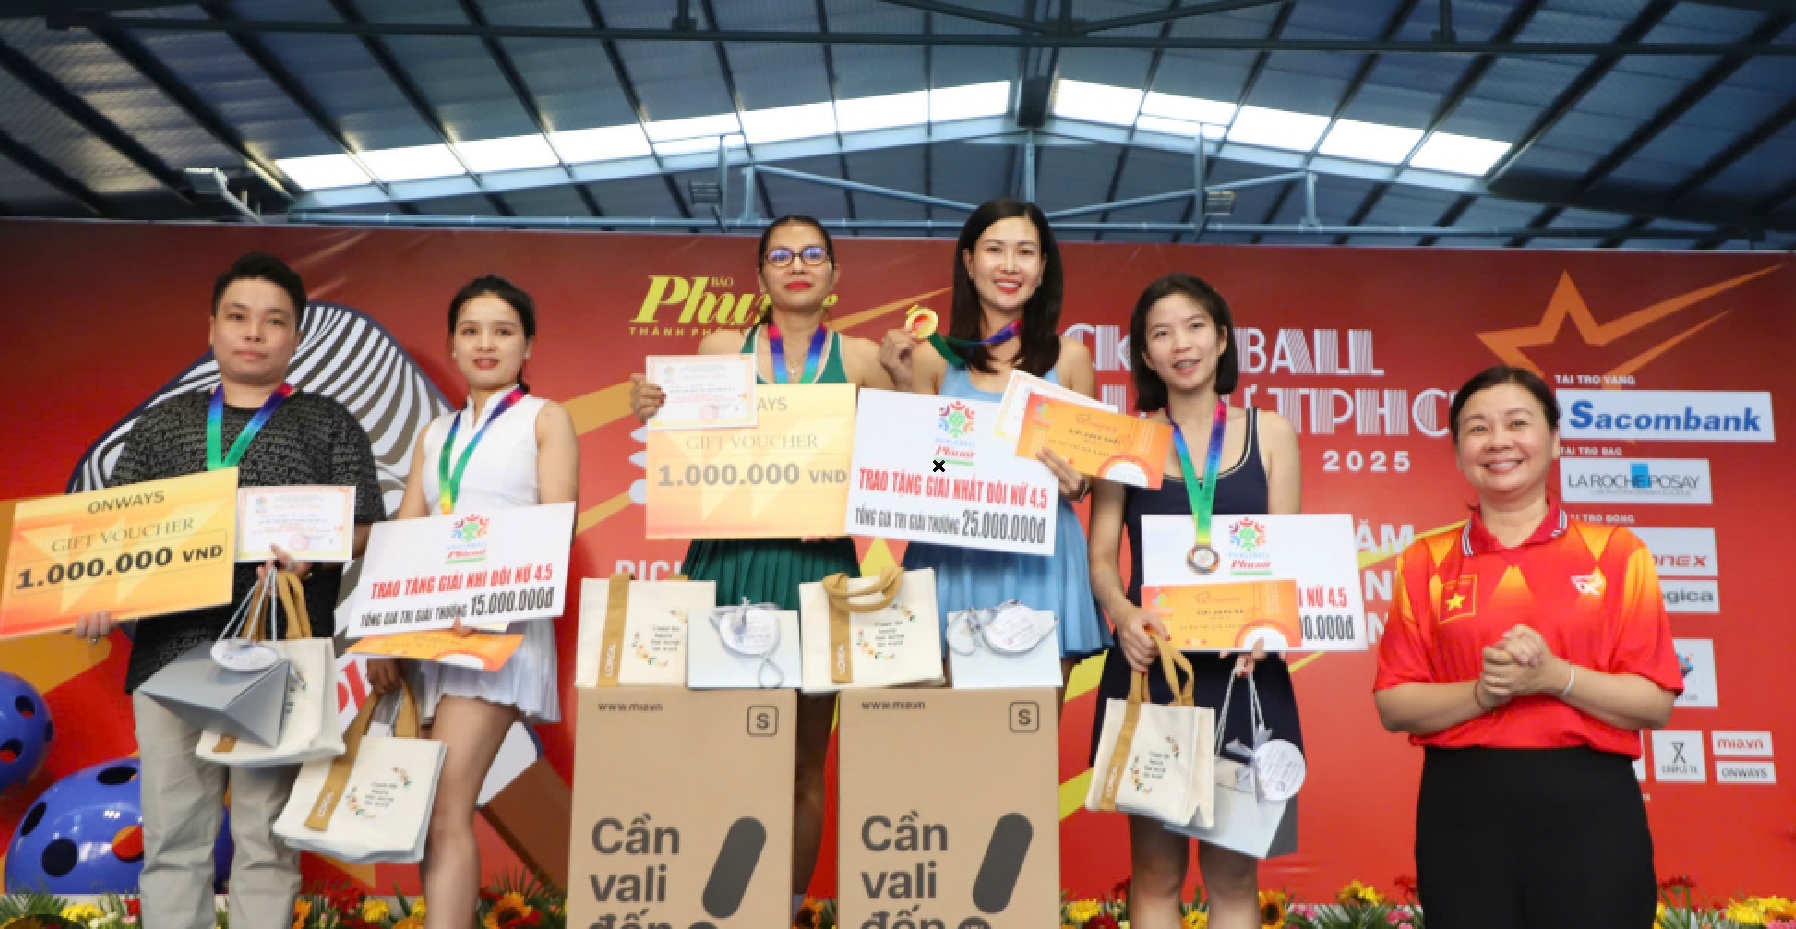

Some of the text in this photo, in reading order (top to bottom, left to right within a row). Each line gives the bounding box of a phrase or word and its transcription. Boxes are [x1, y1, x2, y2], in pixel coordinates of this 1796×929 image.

[757, 396, 788, 413] AYS
[1267, 387, 1456, 438] TPHC
[1568, 399, 1762, 432] Sacombank
[686, 433, 819, 450] GIFT VOUCHER
[657, 463, 848, 487] 1.000.000 VND
[1322, 450, 1411, 473] 2025
[859, 467, 889, 492] TRAO
[1030, 488, 1047, 510] 4.5
[1567, 474, 1588, 490] LA
[87, 489, 165, 515] ONWAYS
[51, 516, 196, 554] GIFT VOUCHER
[15, 544, 224, 590] 1.000.000 VND
[371, 579, 401, 600] TRAO
[534, 562, 553, 582] 4.5
[1328, 586, 1347, 609] 4.5
[756, 712, 770, 730] S
[1018, 709, 1032, 727] S
[1717, 738, 1765, 749] mia.vn
[590, 811, 680, 855] Cần
[860, 809, 949, 852] Cần
[589, 863, 667, 902] vali
[860, 860, 937, 900] vali
